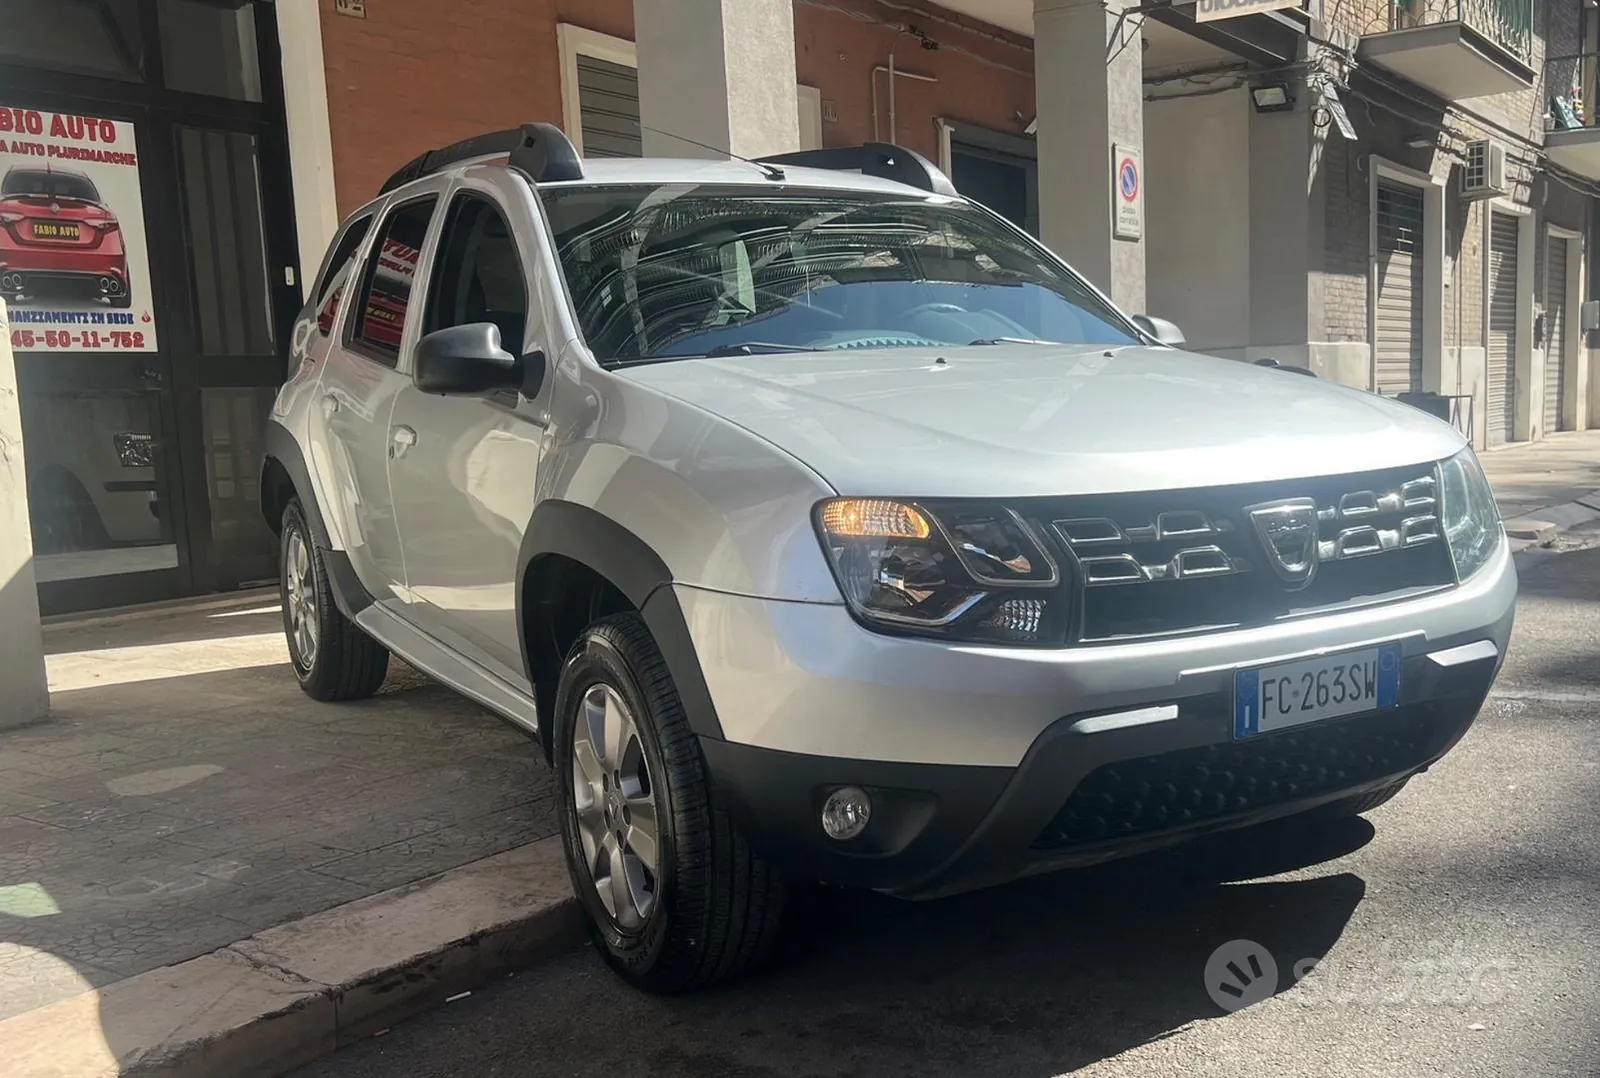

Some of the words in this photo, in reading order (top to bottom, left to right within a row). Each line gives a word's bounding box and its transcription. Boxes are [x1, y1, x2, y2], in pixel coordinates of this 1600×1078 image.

[0, 107, 43, 135] BIO
[50, 113, 116, 143] AUTO
[11, 141, 45, 156] AUTO
[48, 145, 137, 166] PLURIMARCHE
[33, 223, 57, 235] FABIO
[59, 225, 79, 237] AUTO
[91, 312, 104, 324] IN
[107, 312, 135, 325] SEDE
